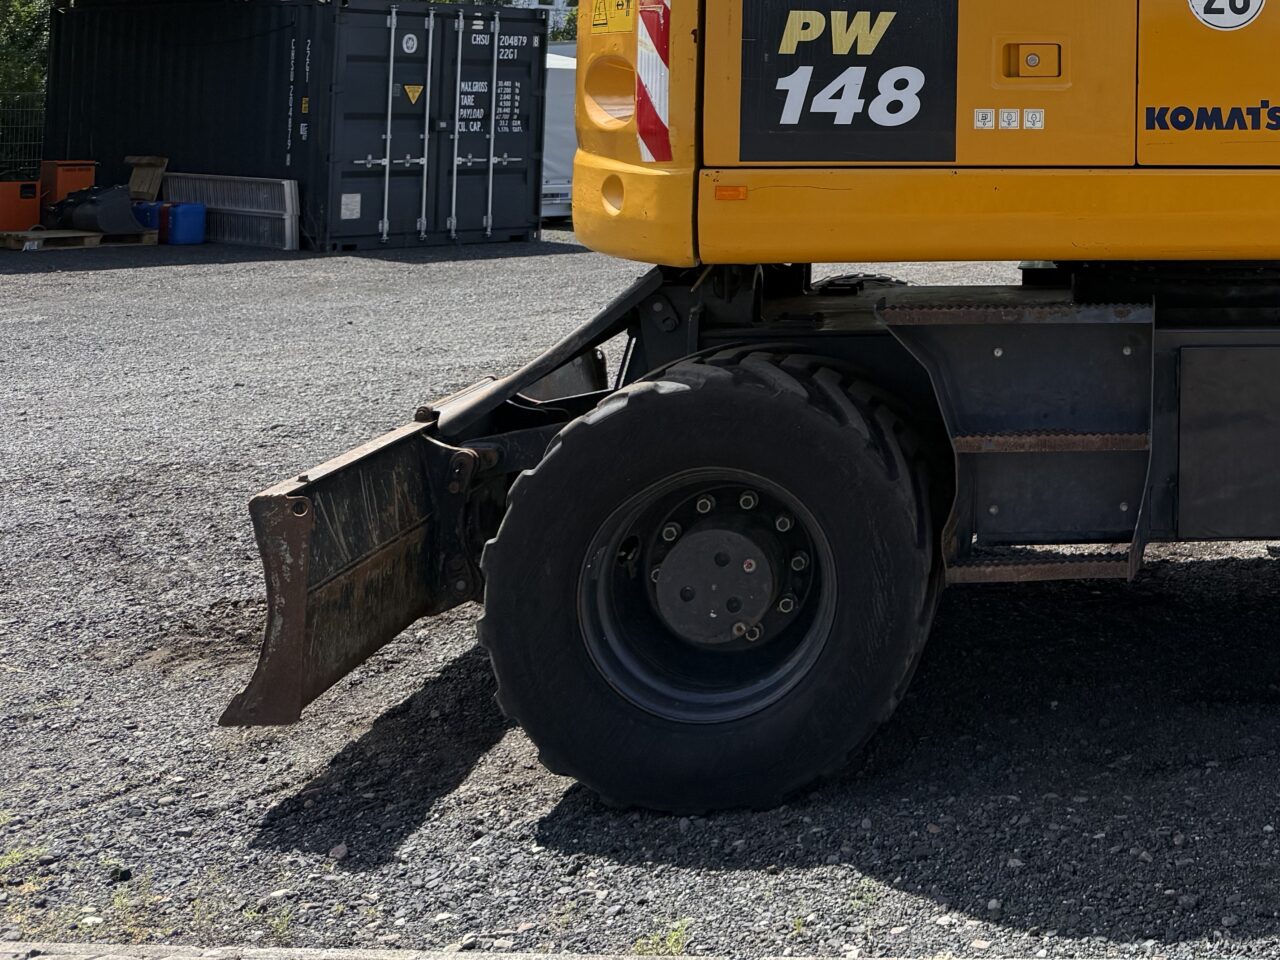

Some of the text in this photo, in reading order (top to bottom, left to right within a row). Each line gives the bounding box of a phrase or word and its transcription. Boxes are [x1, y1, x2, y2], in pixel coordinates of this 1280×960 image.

[778, 10, 897, 55] PW
[471, 33, 490, 46] CHSU
[499, 35, 528, 47] 204879
[499, 48, 518, 60] 22G1
[460, 94, 475, 106] TARE
[775, 66, 926, 128] 148
[459, 108, 485, 119] PAYLOAD
